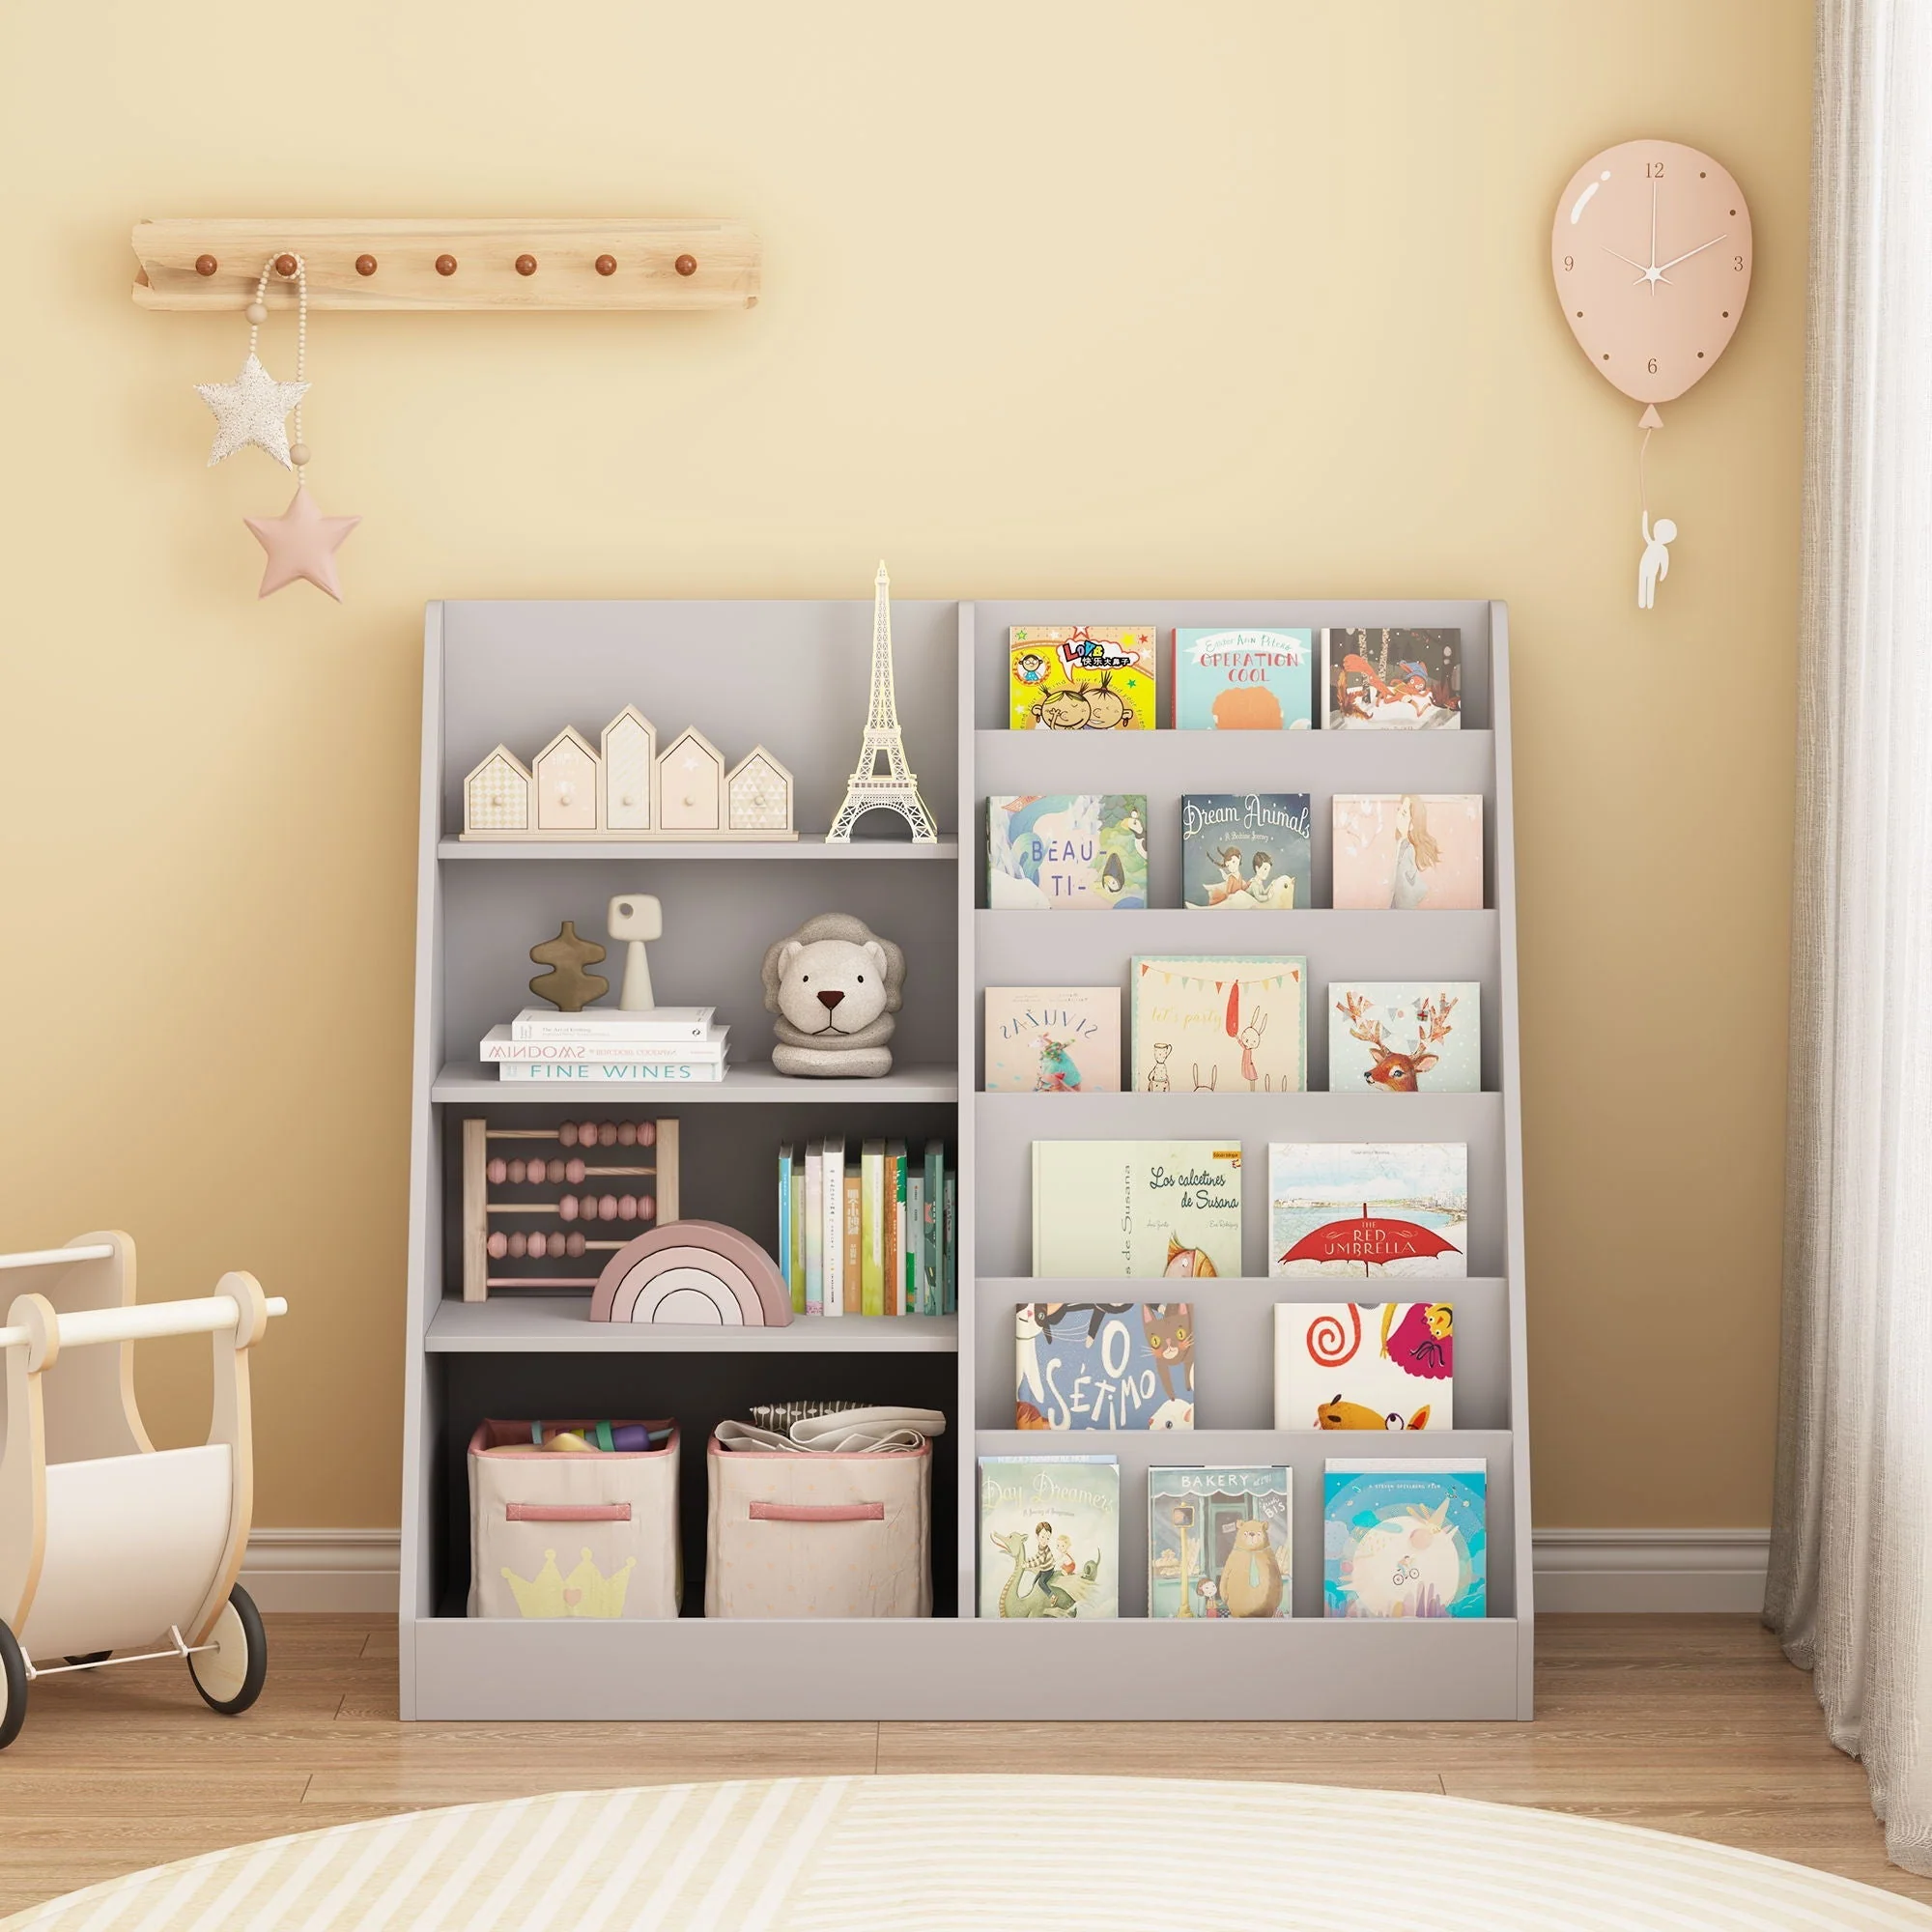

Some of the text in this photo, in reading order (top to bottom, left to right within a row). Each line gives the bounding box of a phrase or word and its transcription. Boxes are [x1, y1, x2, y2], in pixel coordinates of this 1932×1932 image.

[1645, 162, 1664, 179] 12
[1564, 256, 1575, 271] 9
[1734, 256, 1744, 271] 3
[1647, 358, 1658, 374] 6
[1081, 656, 1130, 668] 快乐大鼻子
[1200, 652, 1298, 667] OPERATION
[1228, 668, 1269, 682] COOL
[1183, 793, 1310, 840] Dream Animals
[1051, 875, 1086, 896] TI-
[530, 1065, 589, 1078] FINE
[602, 1065, 691, 1078] WINES
[1150, 1166, 1227, 1189] Los calcetines
[1122, 1165, 1133, 1235] Susana
[1181, 1189, 1239, 1208] de Susana
[1353, 1229, 1386, 1242] RED
[1324, 1242, 1416, 1256] UMBRELLA
[1101, 1320, 1130, 1378] O
[1181, 1474, 1249, 1488] BAKERY
[982, 1470, 1114, 1515] Day Dreamers
